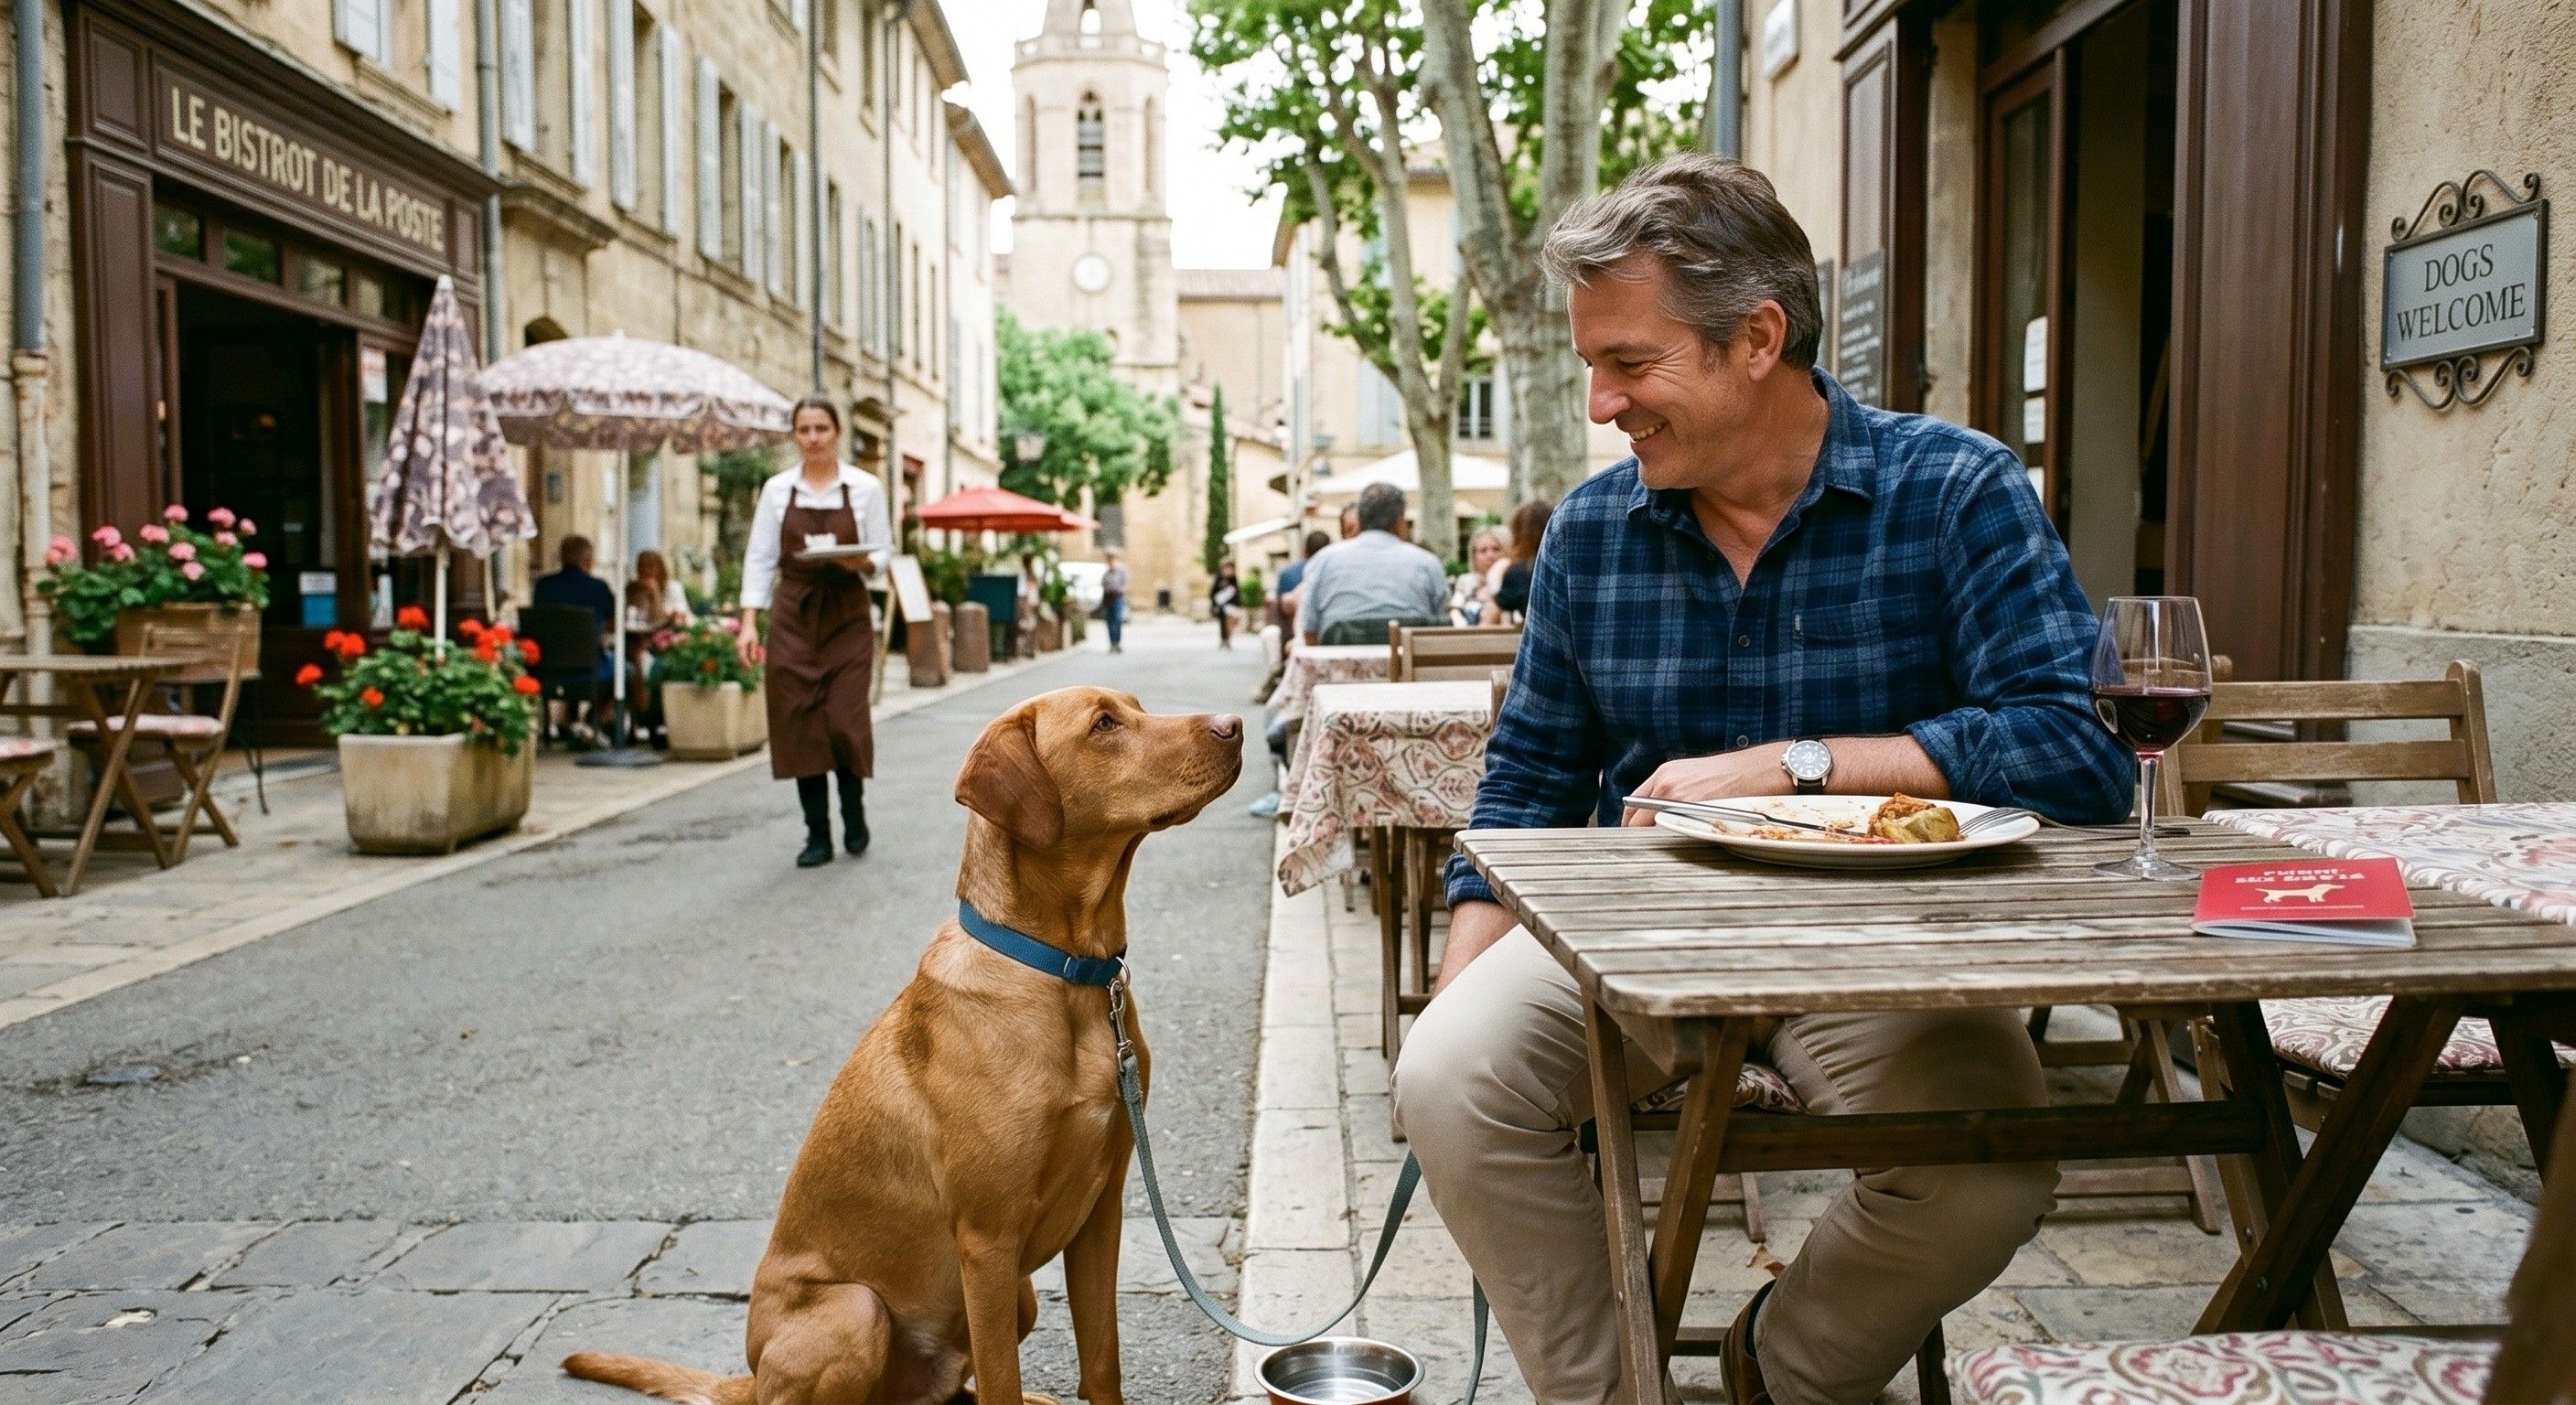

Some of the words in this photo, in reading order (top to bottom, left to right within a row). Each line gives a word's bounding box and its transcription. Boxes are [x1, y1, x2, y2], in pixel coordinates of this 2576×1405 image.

[171, 86, 207, 151] LE
[213, 106, 317, 197] BISTROT
[322, 157, 353, 214] DE
[355, 172, 384, 227] LA
[385, 186, 445, 252] POSTE
[2424, 243, 2495, 293] DOGS
[2397, 283, 2527, 342] WELCOME
